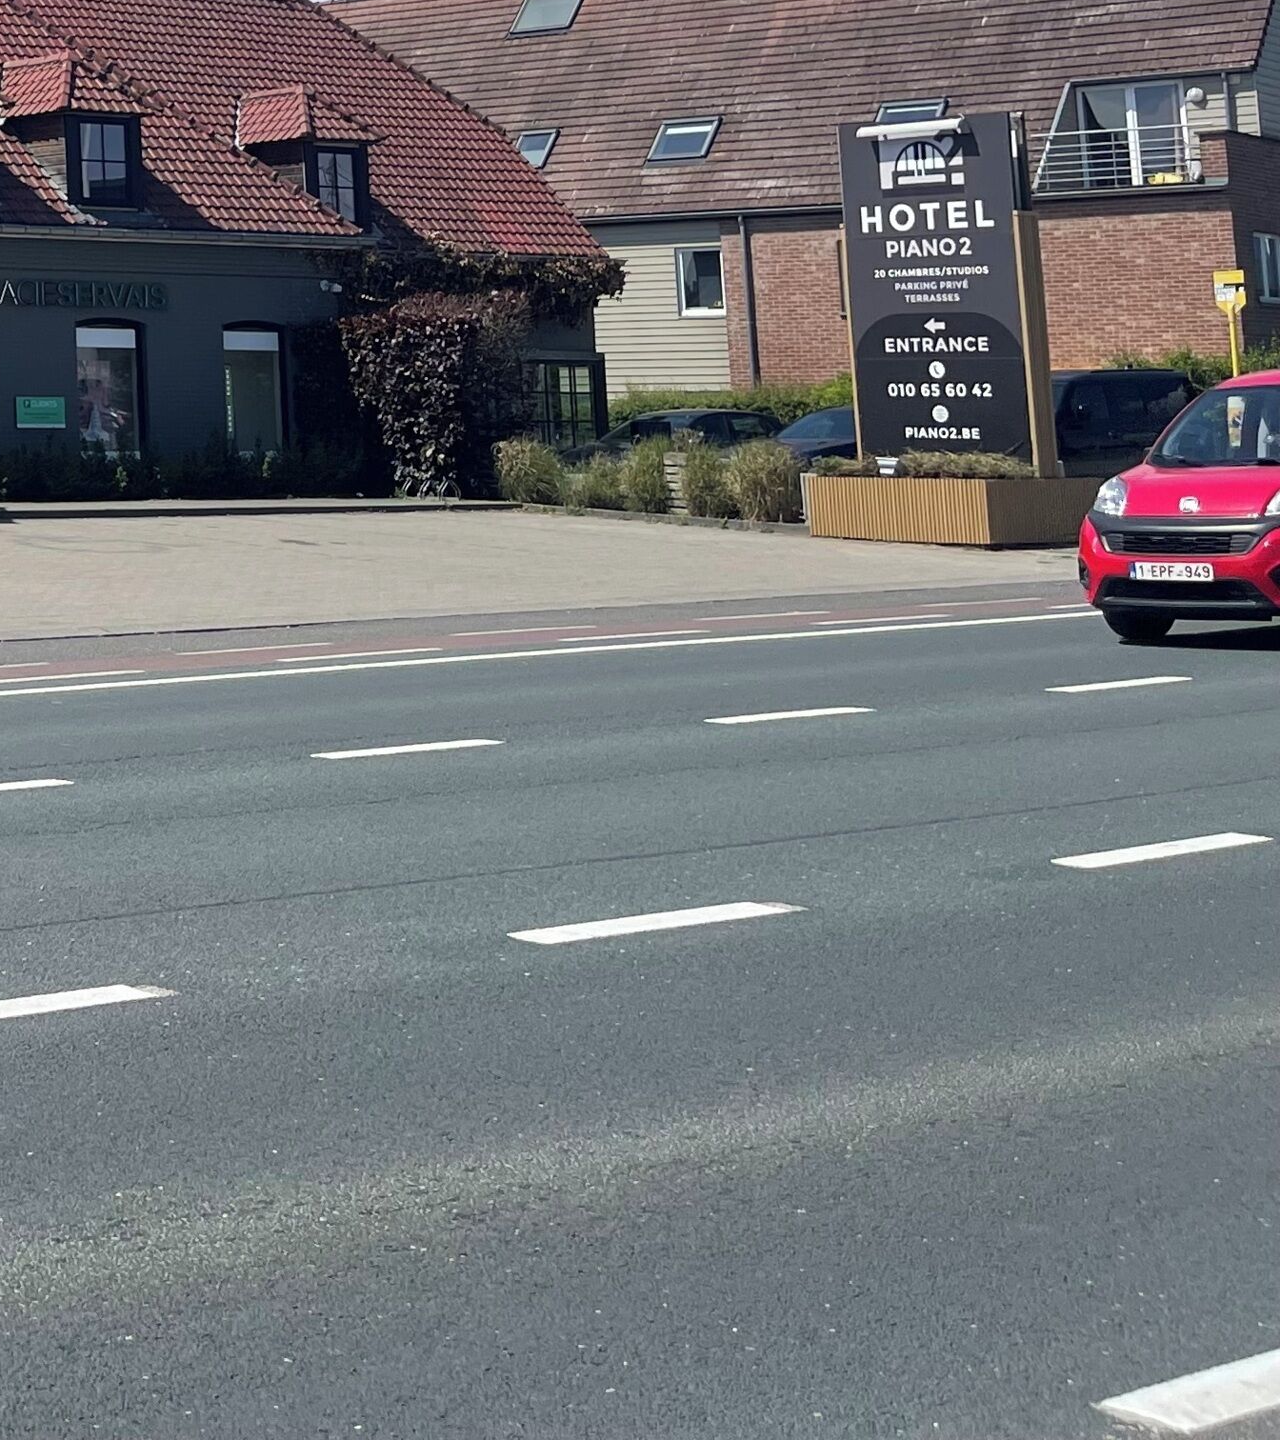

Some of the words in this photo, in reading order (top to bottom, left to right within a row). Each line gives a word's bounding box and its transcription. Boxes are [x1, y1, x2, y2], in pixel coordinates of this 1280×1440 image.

[860, 199, 995, 234] HOTEL
[874, 269, 886, 279] 20
[887, 265, 990, 278] CHAMBRES/STUDIOS
[894, 281, 938, 291] PARKING
[939, 278, 969, 290] PRIVÉ
[904, 292, 961, 303] TERRASSES
[884, 336, 990, 353] ENTRANCE
[887, 383, 916, 397] 010
[920, 383, 940, 397] 65
[944, 383, 967, 397] 60
[971, 383, 993, 397] 42
[904, 426, 981, 439] PIANO2.BE
